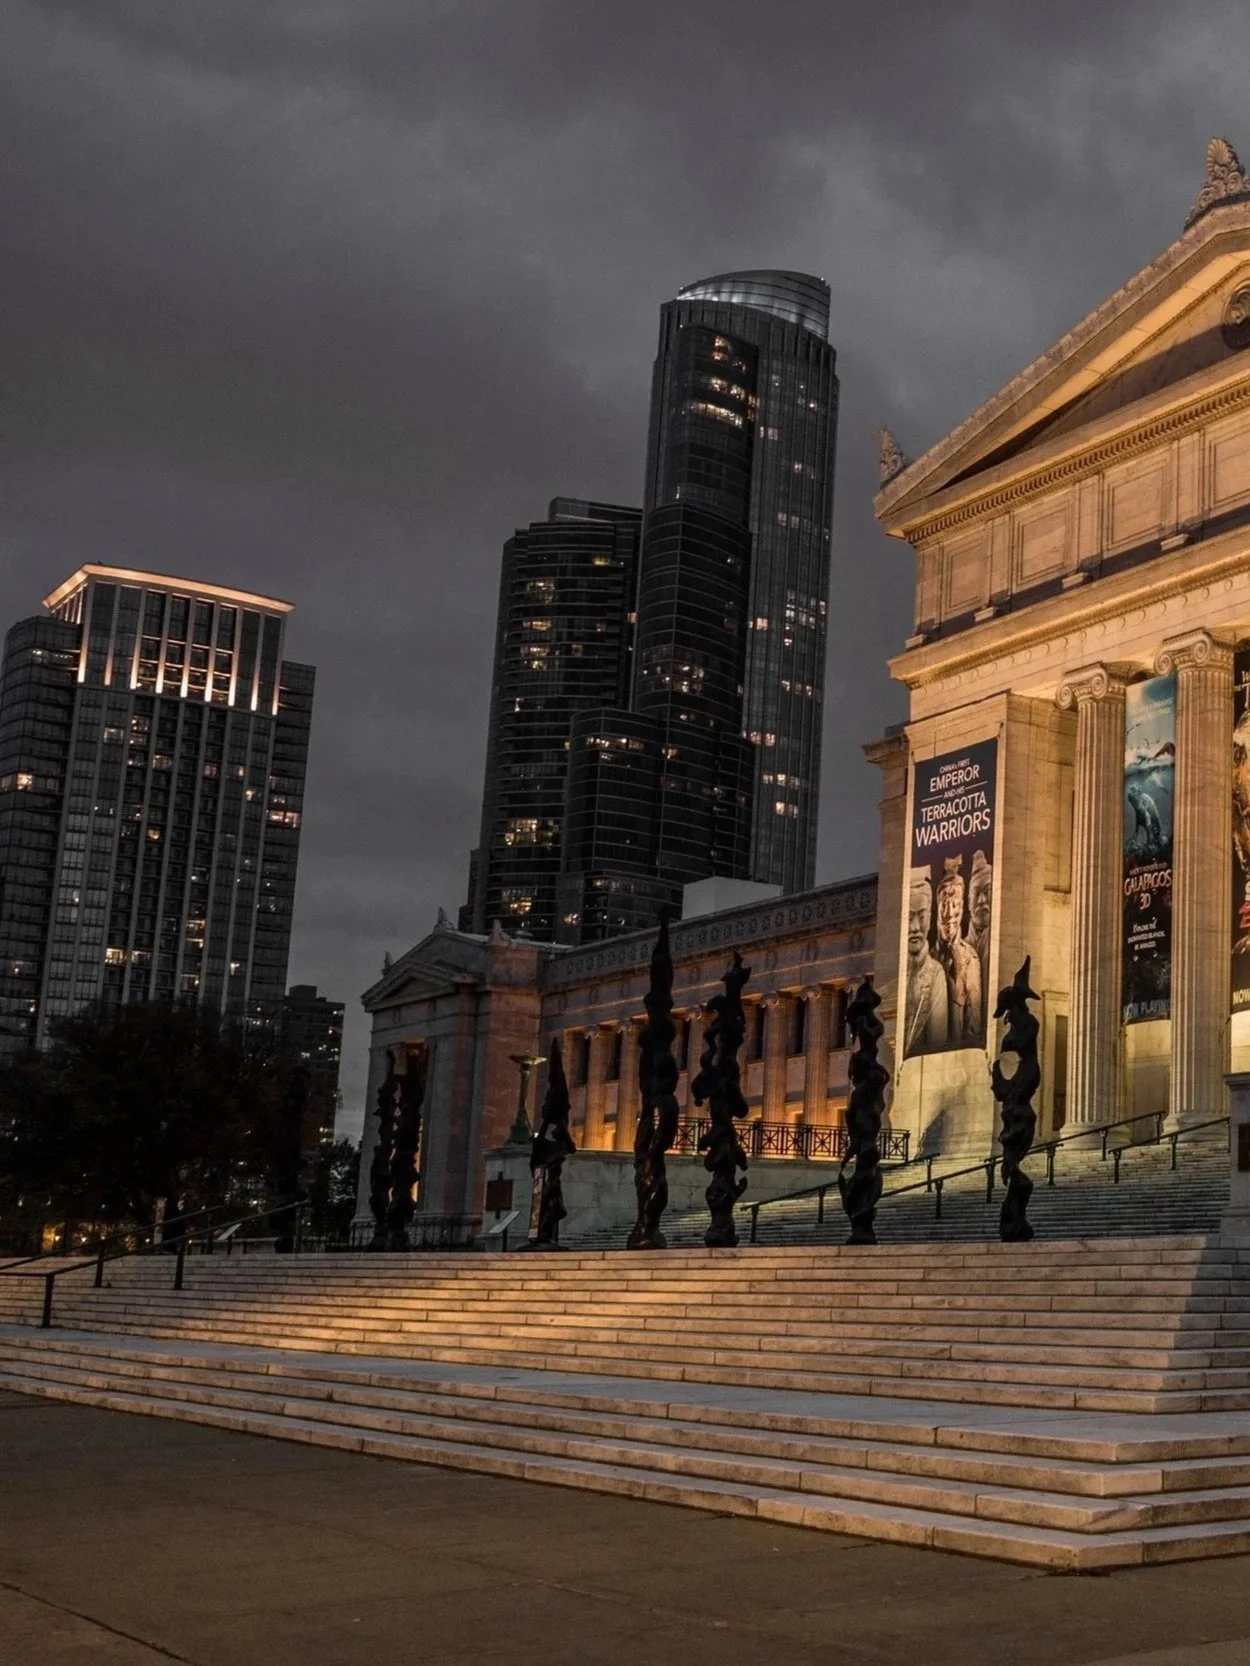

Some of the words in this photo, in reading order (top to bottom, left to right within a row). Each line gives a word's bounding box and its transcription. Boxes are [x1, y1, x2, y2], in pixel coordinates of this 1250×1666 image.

[929, 764, 980, 792] EMPEROR
[921, 791, 987, 823] TERRACOTTA
[943, 788, 956, 798] AND
[915, 808, 991, 848] WARRIORS
[1124, 868, 1172, 896] GALAPAGOS
[1139, 892, 1151, 910] 3D
[1232, 988, 1250, 1005] NOW
